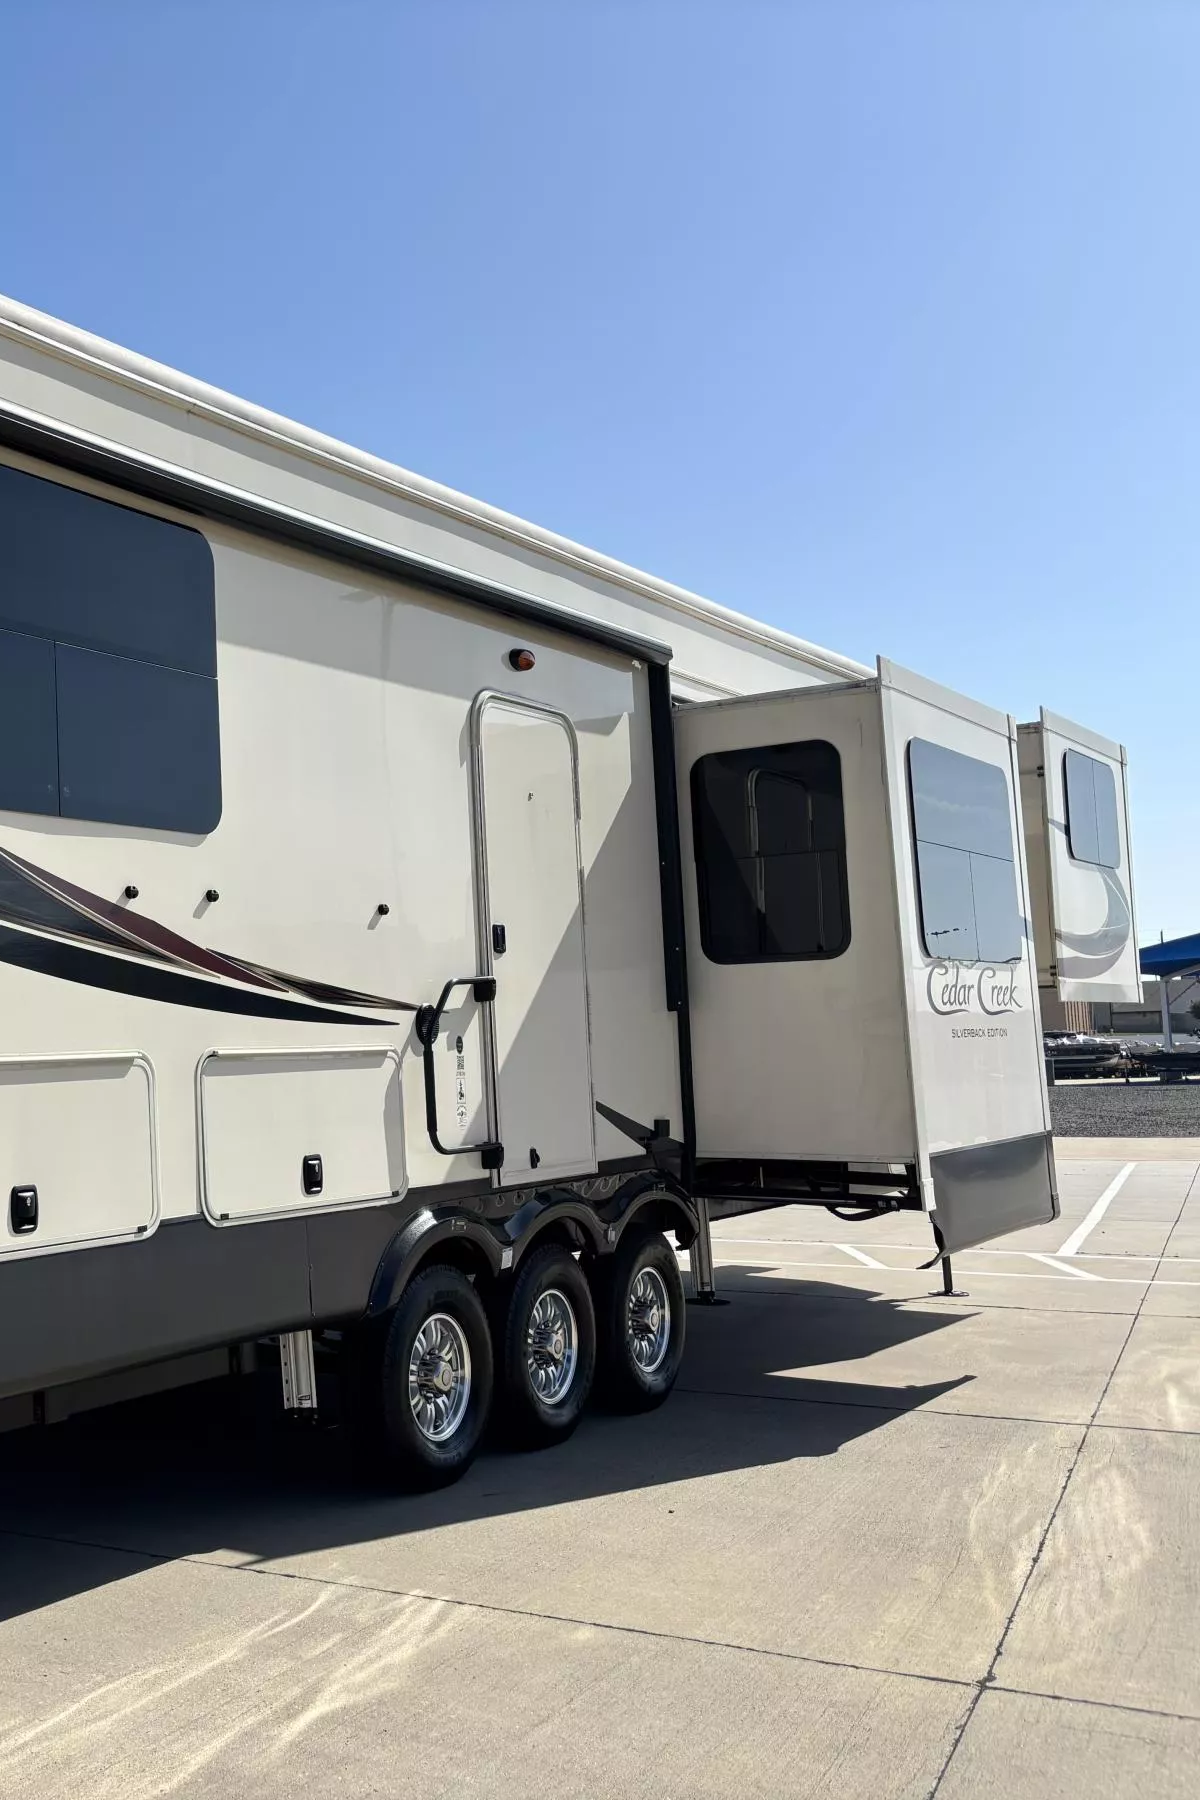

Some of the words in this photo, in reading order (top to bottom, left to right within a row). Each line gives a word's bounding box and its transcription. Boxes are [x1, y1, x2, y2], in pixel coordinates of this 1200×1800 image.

[926, 962, 974, 1015] Cedar
[977, 965, 1023, 1015] Creek
[951, 1028, 986, 1038] SILVERBACK
[987, 1027, 1008, 1037] EDITION
